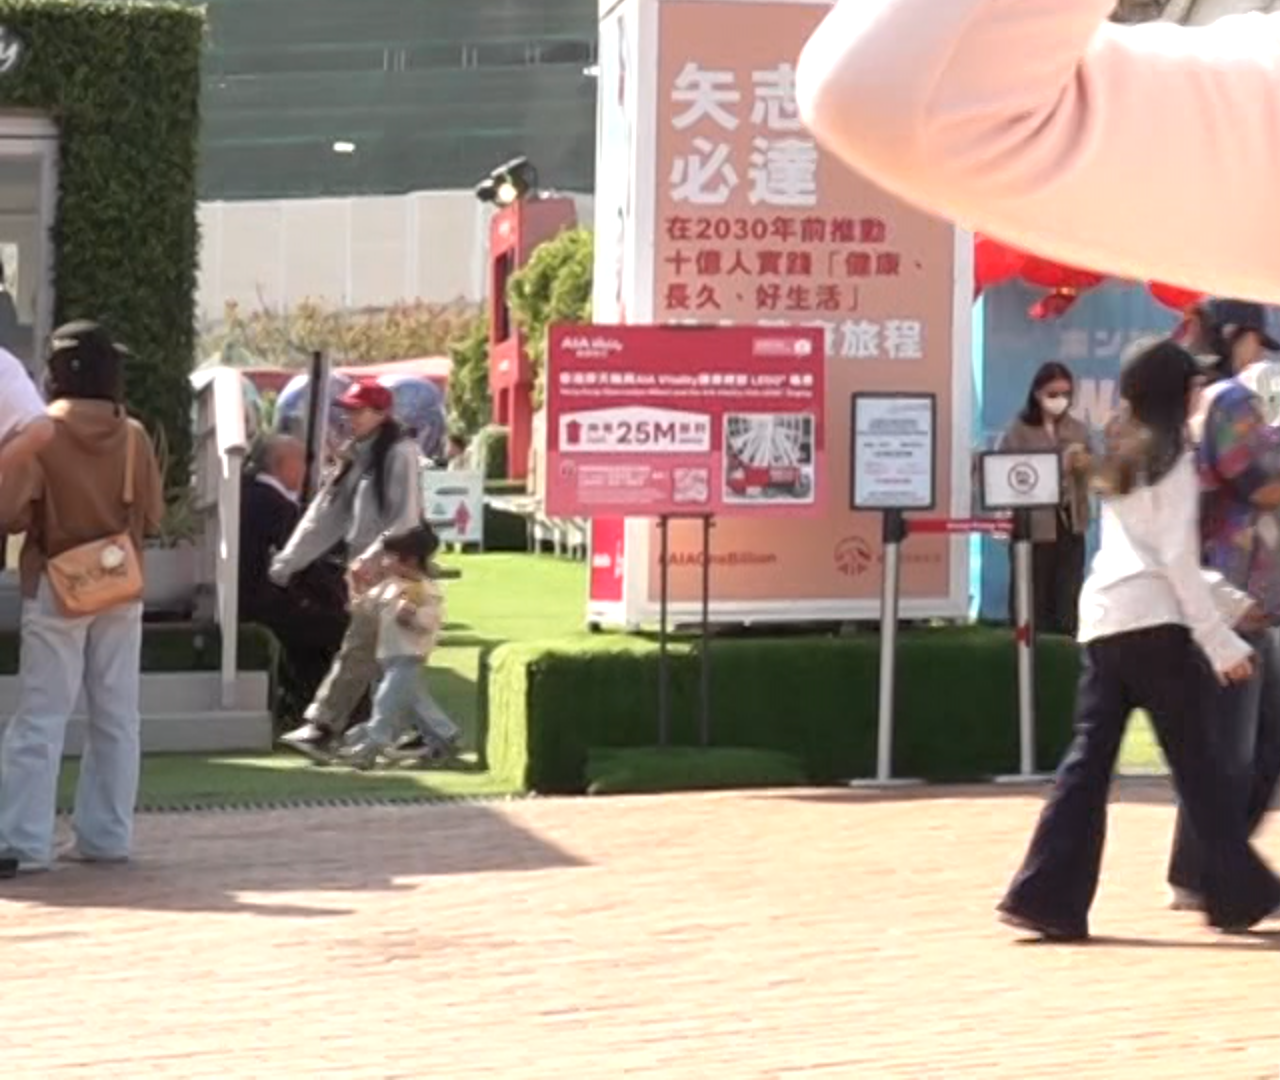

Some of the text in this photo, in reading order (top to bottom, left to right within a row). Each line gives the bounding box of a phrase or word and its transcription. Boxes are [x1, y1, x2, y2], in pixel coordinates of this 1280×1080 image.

[670, 136, 818, 206] 必達
[665, 216, 886, 243] 在2030年前推動
[616, 421, 676, 445] 25M
